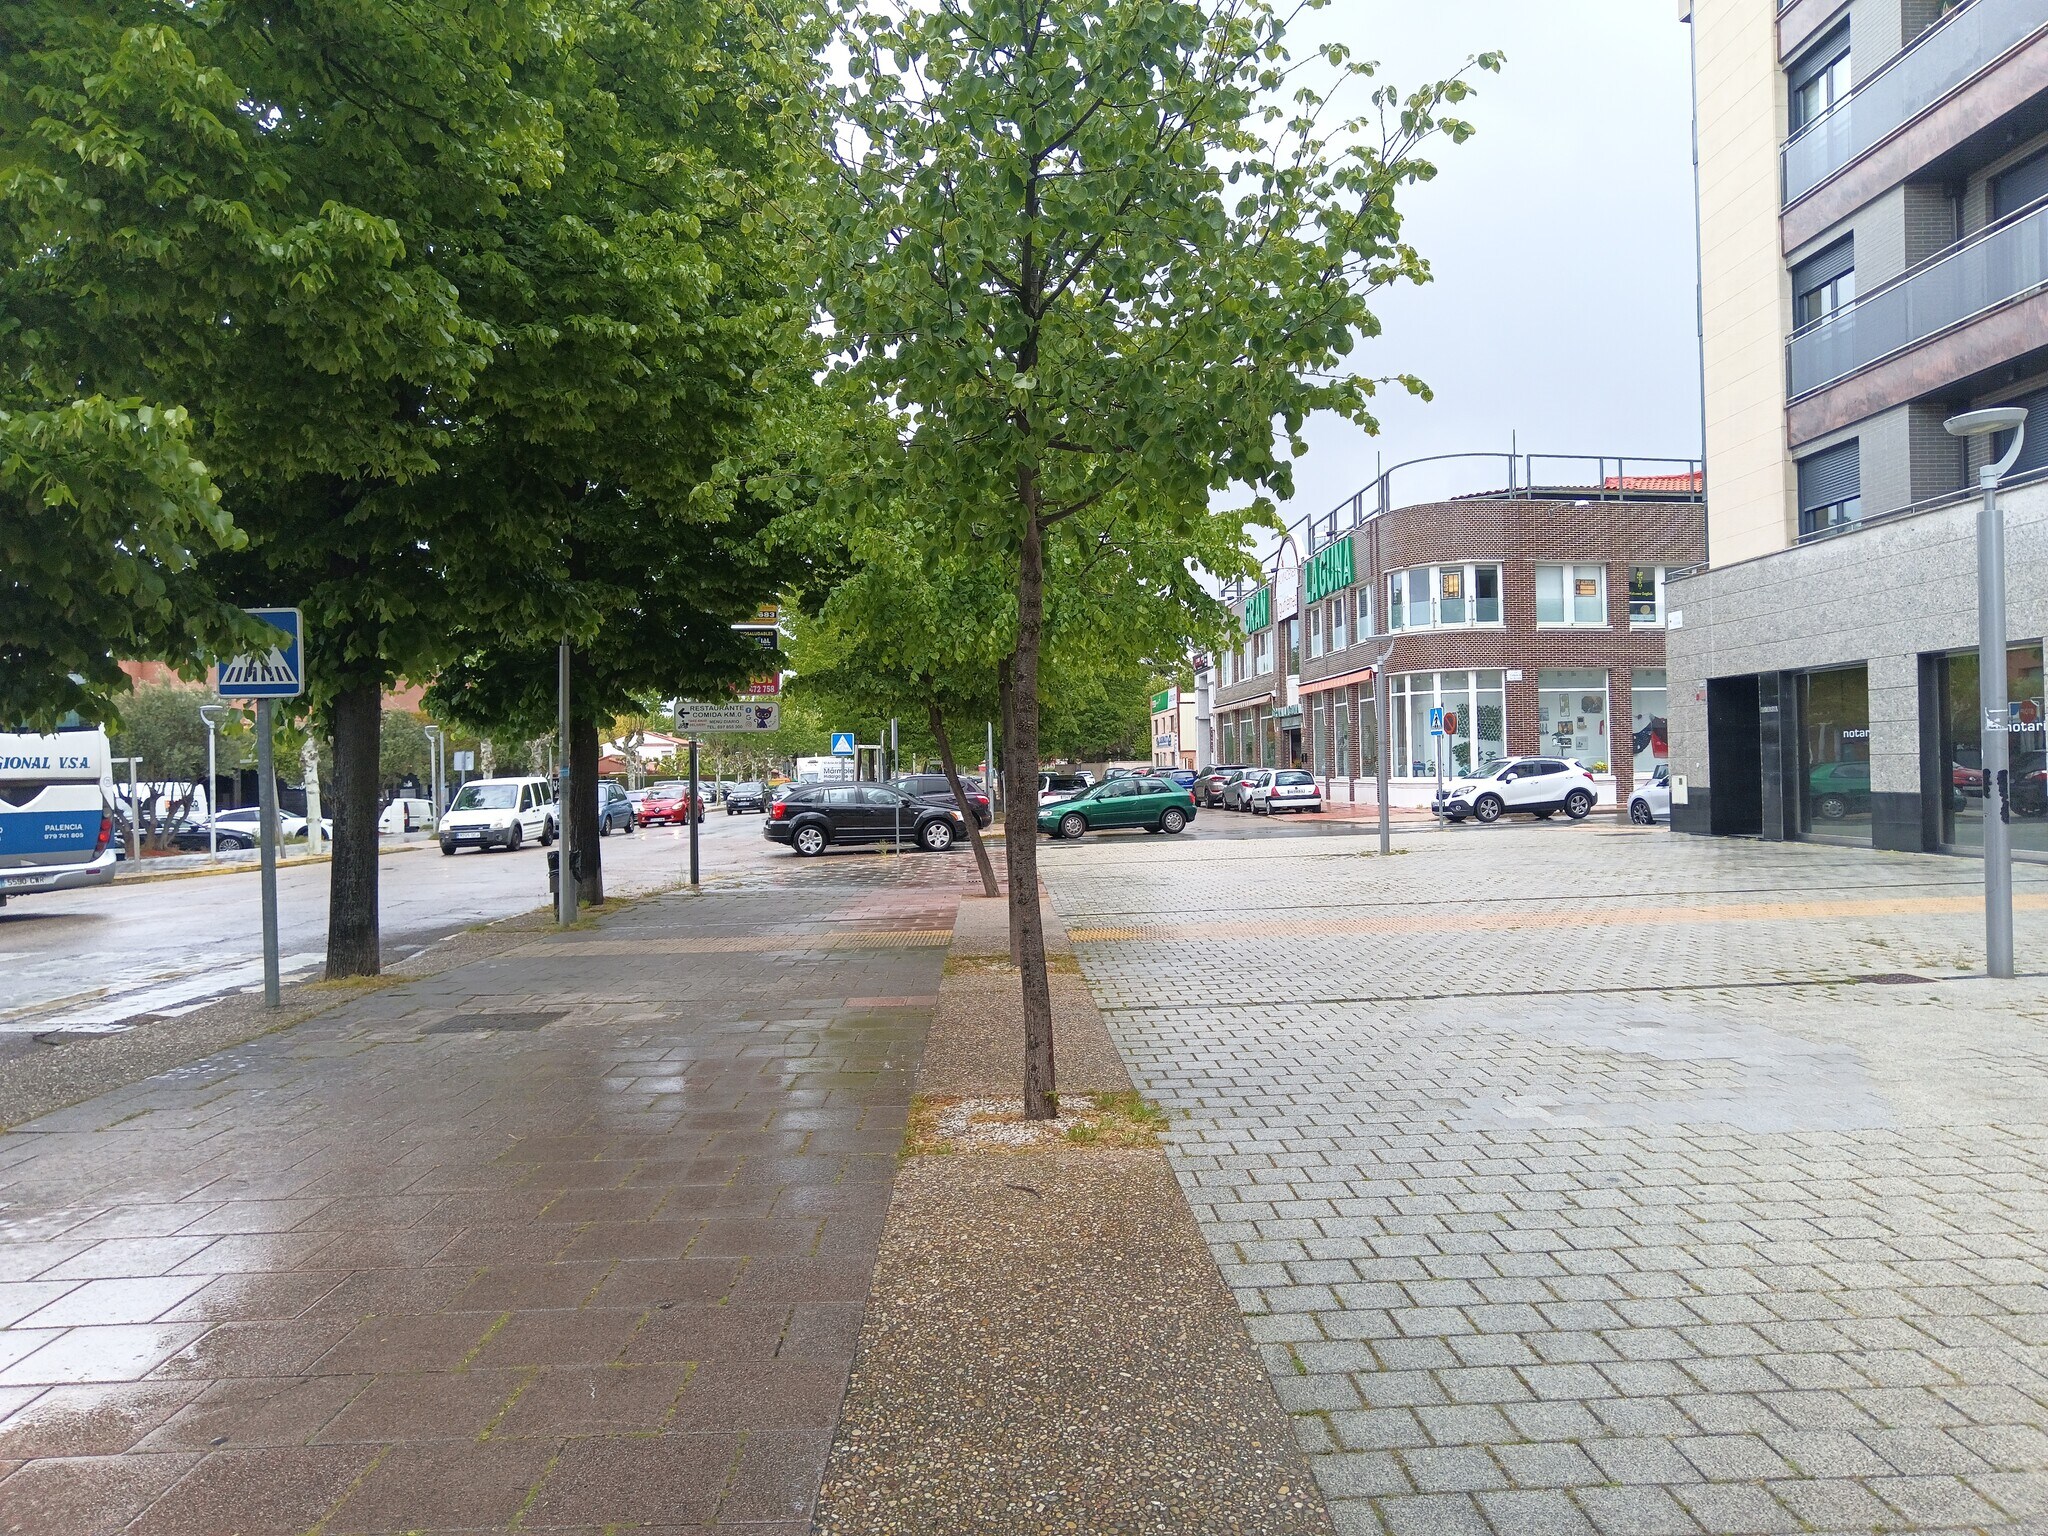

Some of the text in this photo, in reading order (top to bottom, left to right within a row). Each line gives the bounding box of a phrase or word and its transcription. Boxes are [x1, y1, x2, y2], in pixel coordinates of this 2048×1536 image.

[1305, 536, 1354, 604] LAGUNA
[1245, 587, 1269, 634] GRAN
[763, 685, 775, 693] 758
[692, 711, 723, 719] COMIDA
[44, 823, 83, 832] PALENCIA
